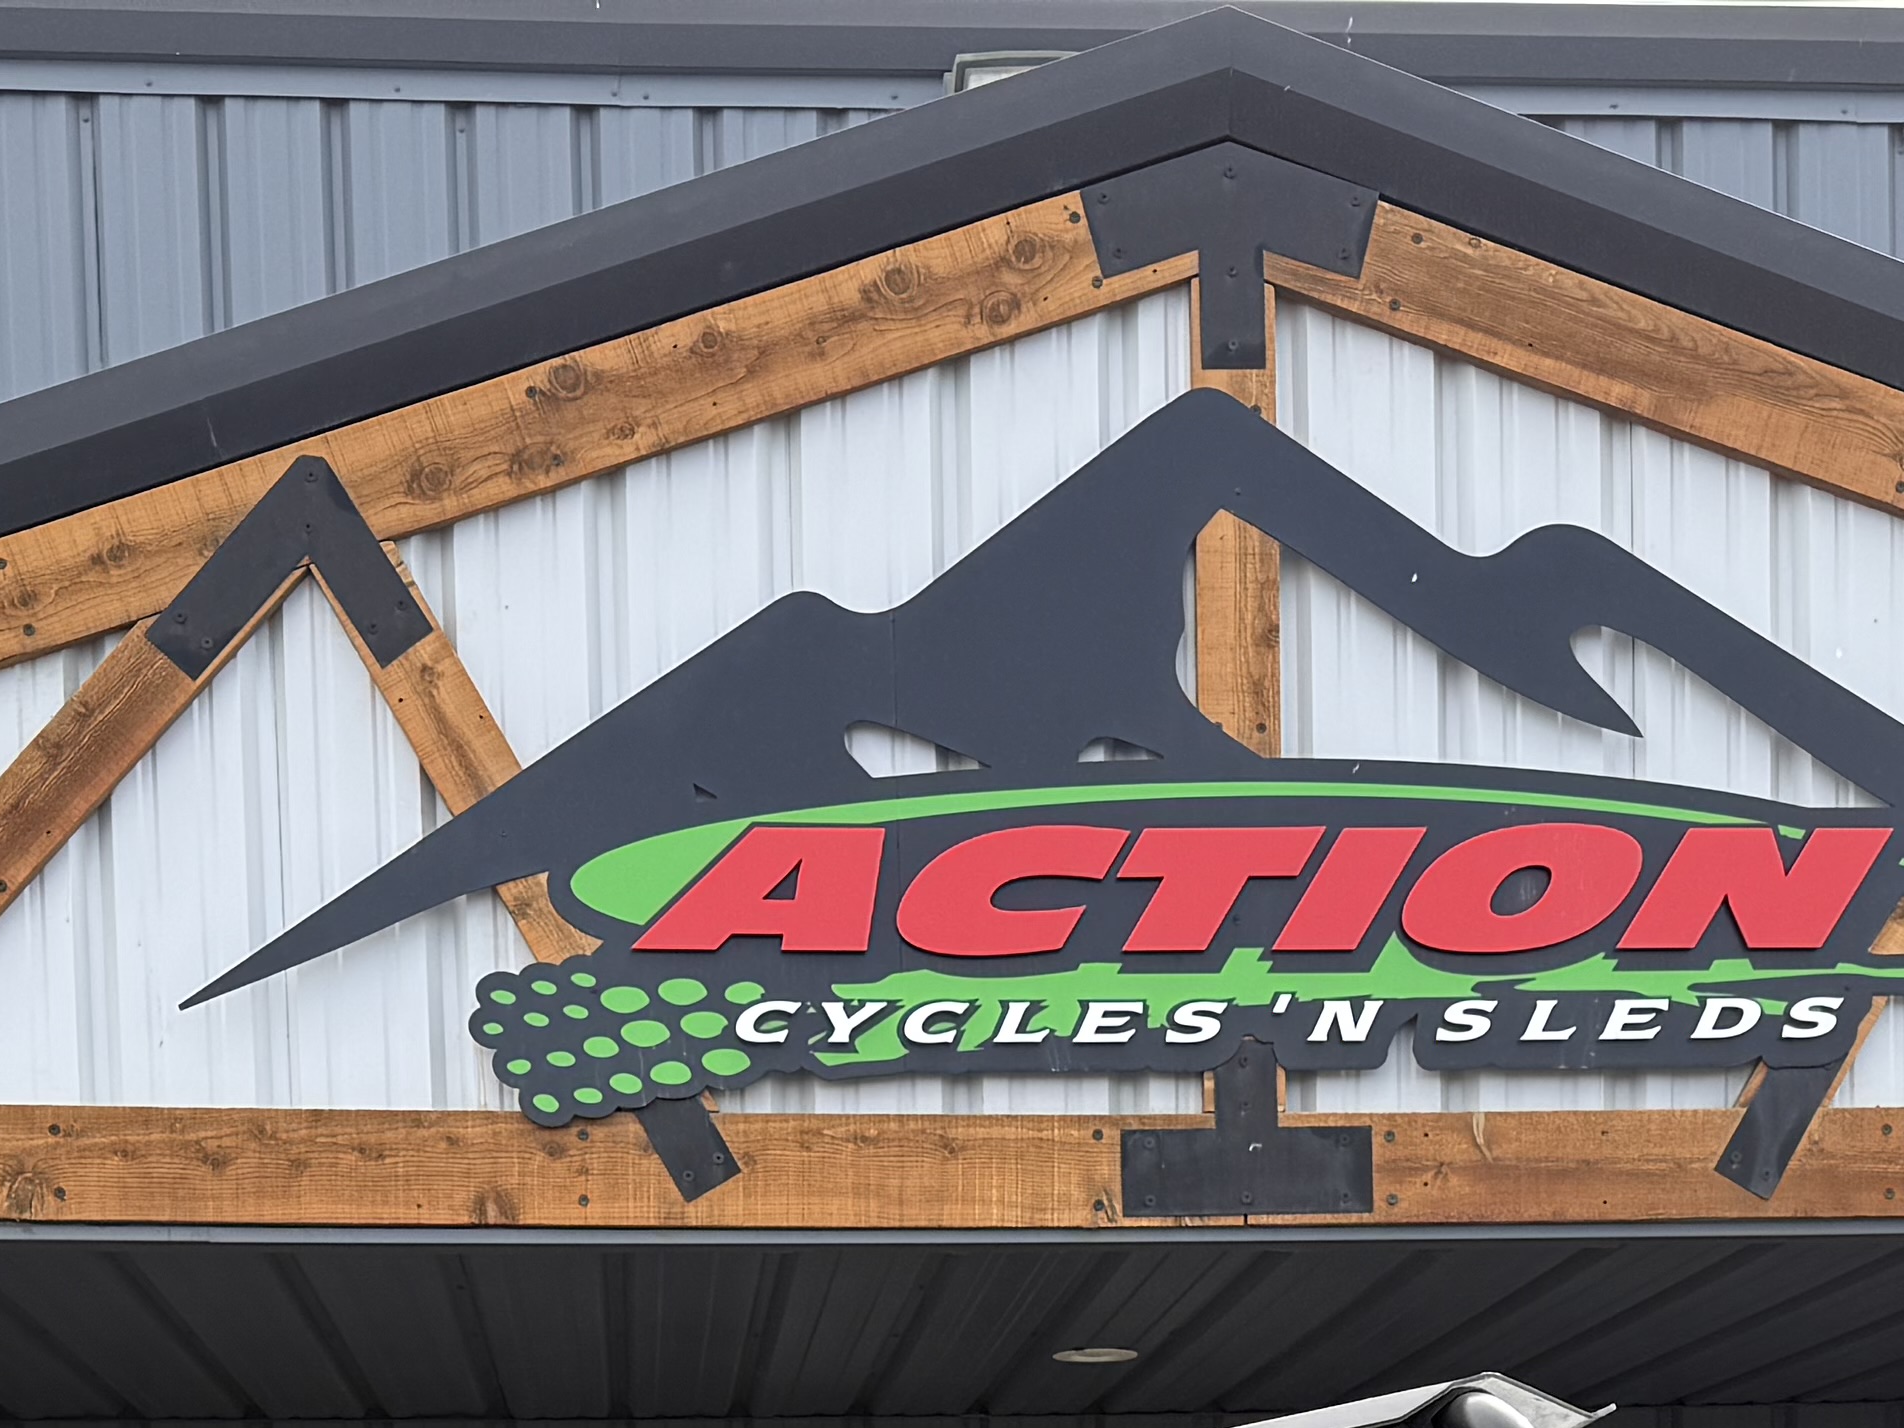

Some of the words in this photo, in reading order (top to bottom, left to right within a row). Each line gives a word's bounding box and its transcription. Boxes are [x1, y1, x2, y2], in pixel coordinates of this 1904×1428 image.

[632, 823, 1893, 957] ACTION
[735, 1000, 1224, 1044] CYCLES
[1271, 994, 1383, 1042] 'N
[1435, 997, 1845, 1041] SLEDS
